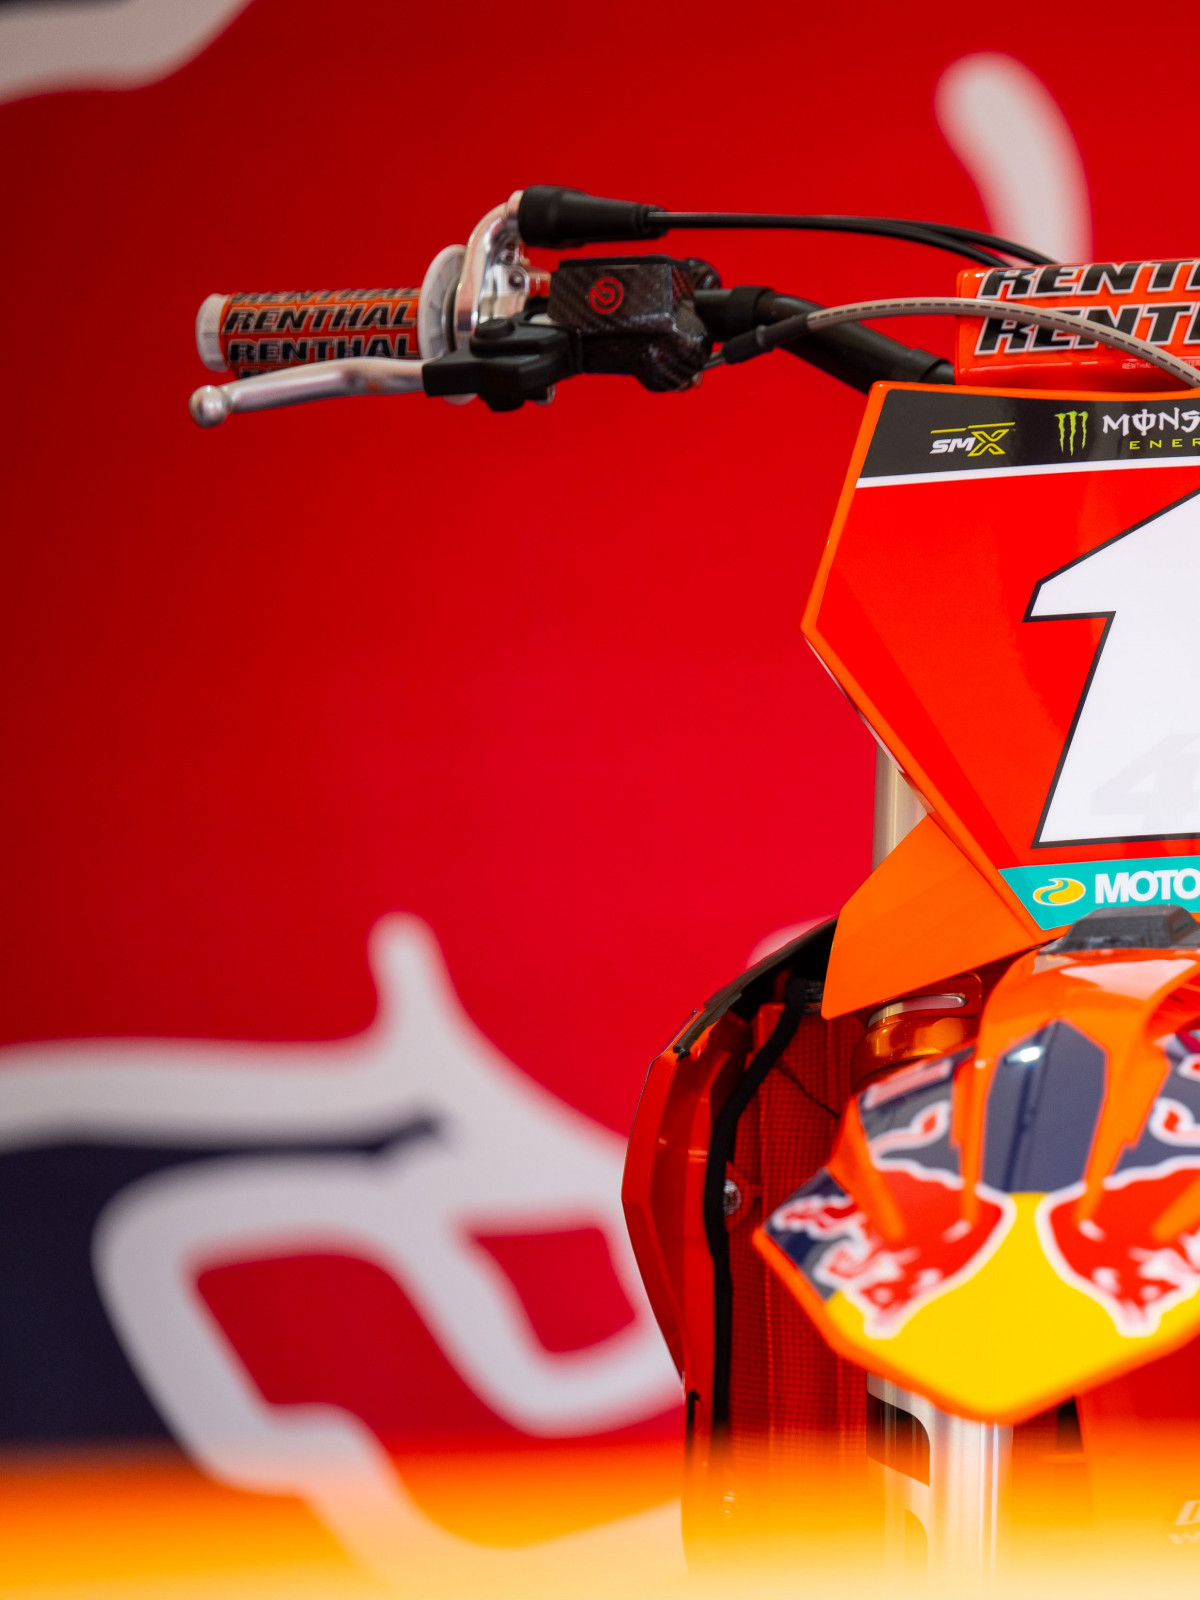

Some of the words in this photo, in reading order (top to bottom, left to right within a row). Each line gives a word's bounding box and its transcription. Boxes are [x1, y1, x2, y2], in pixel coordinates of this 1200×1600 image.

[221, 302, 417, 335] RENTHAL
[228, 335, 421, 363] RENTHAL
[930, 430, 1010, 457] SMX
